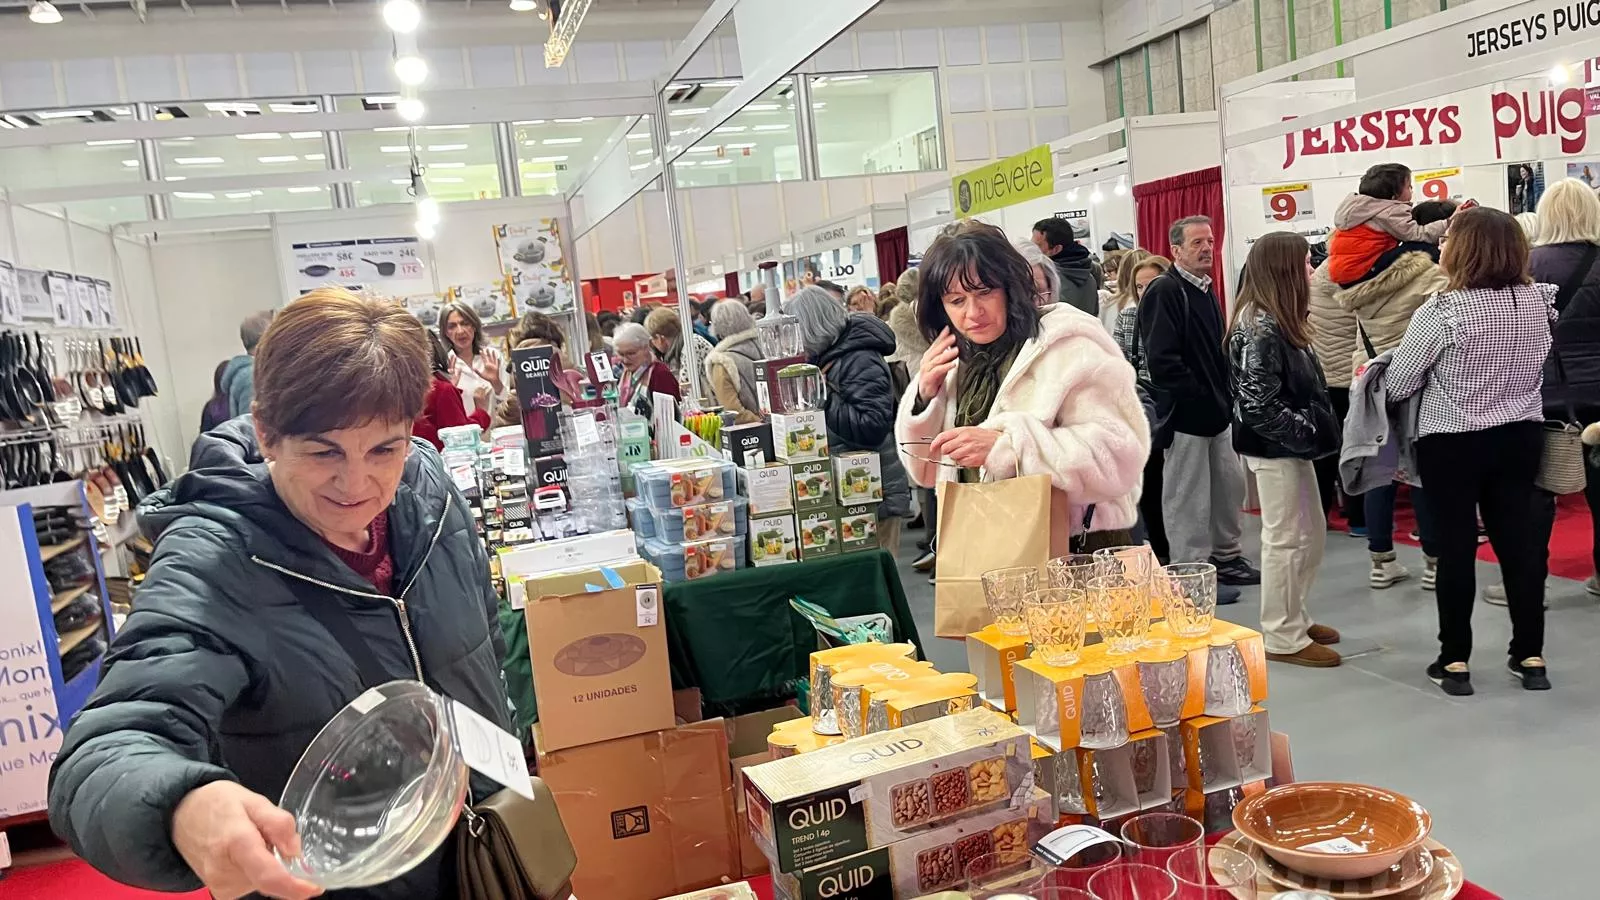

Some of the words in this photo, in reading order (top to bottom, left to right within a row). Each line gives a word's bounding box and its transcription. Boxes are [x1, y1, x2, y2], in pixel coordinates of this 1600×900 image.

[1467, 13, 1547, 58] JERSEYS
[1282, 106, 1462, 170] JERSEYS
[973, 156, 1043, 204] muévete
[1422, 179, 1448, 202] 9
[1270, 193, 1297, 221] 9
[836, 265, 854, 276] DO
[520, 358, 550, 372] QUID
[796, 415, 815, 424] QUID
[741, 436, 760, 446] QUID
[803, 463, 822, 472] QUID
[851, 457, 870, 466] QUID
[543, 469, 569, 483] QUI
[760, 470, 778, 479] QUID
[808, 511, 828, 521] QUID
[848, 506, 867, 515] QUID
[508, 520, 525, 528] QUID
[572, 694, 584, 704] 12
[587, 684, 638, 702] UNIDADES
[1062, 685, 1077, 720] QUID
[849, 738, 924, 764] QUID
[788, 798, 847, 830] QUID
[791, 832, 815, 845] TREND
[818, 865, 874, 899] QUID
